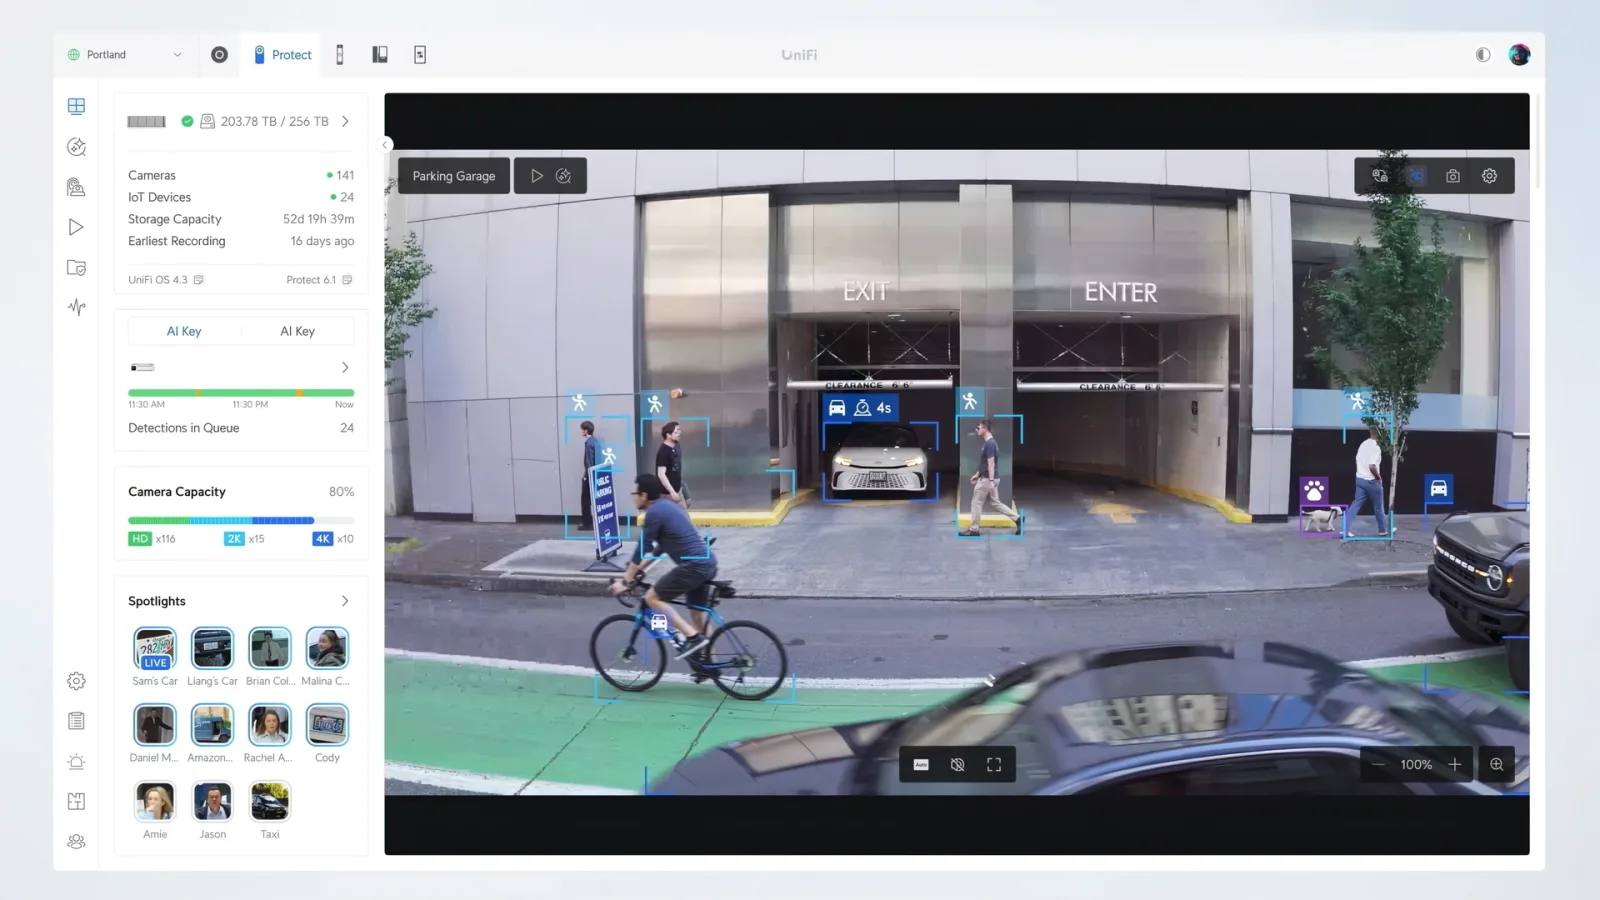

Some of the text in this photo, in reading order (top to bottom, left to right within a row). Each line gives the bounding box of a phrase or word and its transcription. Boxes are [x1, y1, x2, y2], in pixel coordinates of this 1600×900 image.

[87, 50, 126, 59] Portland
[272, 50, 312, 60] Protect
[781, 50, 817, 60] UniFi
[220, 116, 258, 126] 203.78
[261, 116, 277, 126] TB
[288, 116, 310, 126] 256
[313, 116, 329, 126] TB
[127, 170, 176, 180] Cameras
[336, 170, 353, 180] 141
[412, 171, 495, 183] Parking Garage
[128, 192, 191, 202] IoT Devices
[339, 192, 354, 202] 24
[128, 214, 222, 226] Storage Capacity
[283, 214, 354, 224] 52d 19h 39m
[128, 236, 225, 248] Earliest Recording
[290, 236, 354, 248] 16 days ago
[128, 275, 188, 284] UniFi OS 4.3
[286, 275, 335, 284] Protect 6.1
[844, 280, 890, 301] EXIT
[1085, 281, 1158, 303] ENTER
[166, 326, 202, 338] AI Key
[280, 326, 315, 338] AI Key
[825, 381, 883, 389] CLEARANCE
[1080, 383, 1136, 391] CLEARANCE
[876, 402, 891, 413] 4s
[128, 423, 239, 434] Detections in Queue
[339, 423, 354, 433] 24
[128, 486, 226, 499] Camera Capacity
[328, 486, 354, 496] 80%
[595, 486, 612, 498] ARKING
[132, 534, 148, 543] HD
[155, 535, 175, 543] x116
[227, 533, 240, 543] 2K
[248, 534, 264, 543] x15
[315, 535, 329, 543] 4K
[337, 534, 354, 543] x10
[128, 596, 186, 608] Spotlights
[144, 658, 167, 667] LIVE
[160, 676, 178, 685] Car
[220, 677, 238, 685] Car
[246, 676, 270, 685] Brian
[301, 677, 332, 685] Malina
[129, 753, 159, 762] Daniel
[243, 753, 275, 762] Rachel
[314, 753, 340, 764] Cody
[1400, 759, 1432, 769] 100%
[142, 830, 167, 838] Amie
[199, 830, 226, 838] Jason
[259, 830, 279, 838] Taxi
